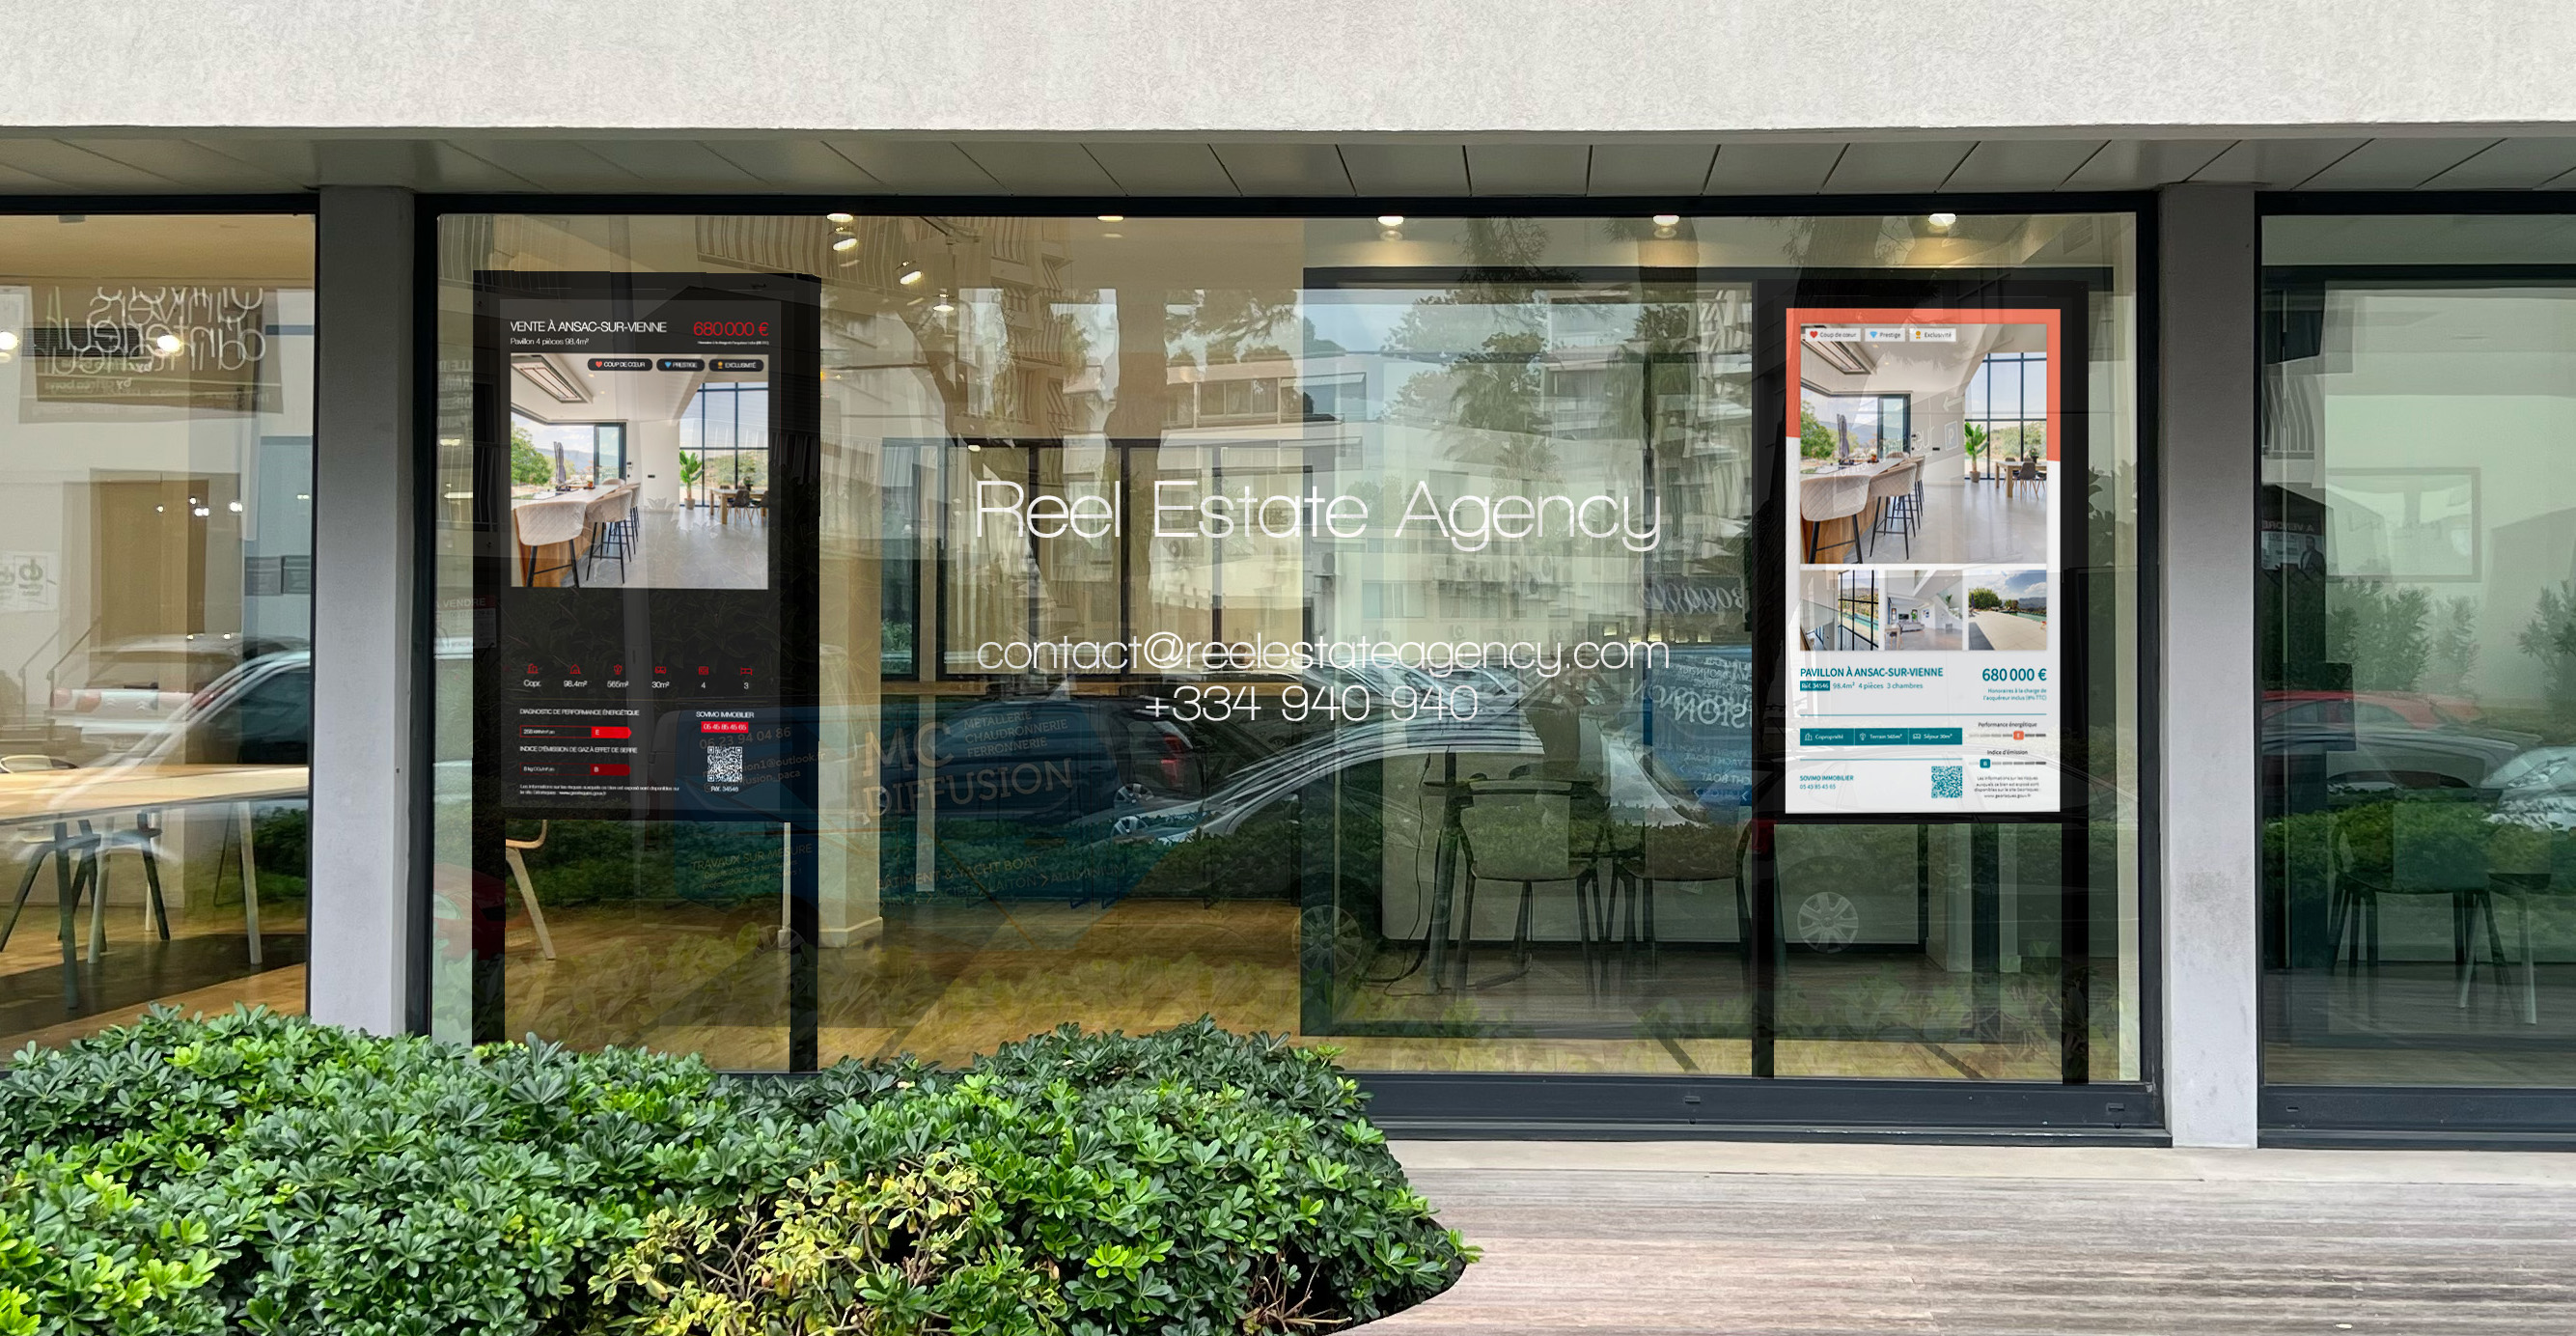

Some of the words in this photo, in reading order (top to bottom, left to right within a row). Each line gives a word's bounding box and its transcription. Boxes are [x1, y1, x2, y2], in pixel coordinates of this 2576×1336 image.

[511, 320, 545, 332] VENTE
[548, 319, 556, 332] À
[558, 321, 667, 333] ANSAC-SUR-VIENNE
[693, 321, 723, 337] 680
[725, 321, 755, 337] 000
[759, 321, 769, 337] €
[1879, 331, 1901, 340] Prestige
[977, 479, 1122, 539] Reel
[1153, 479, 1368, 539] Estate
[1395, 480, 1662, 553] Agency
[443, 598, 485, 608] VENDRE
[977, 630, 1669, 676] contact@reelestateagency.com
[1800, 667, 1844, 677] PAVILLON
[1846, 666, 1853, 677] À
[1854, 667, 1944, 677] ANSAC-SUR-VIENNE
[1982, 668, 2007, 682] 680
[2009, 668, 2035, 682] 000
[2038, 668, 2047, 682] €
[1864, 682, 1884, 691] pièces
[1144, 683, 1263, 722] +334
[1280, 683, 1371, 722] 940
[1389, 683, 1480, 722] 940
[964, 718, 1069, 744] CHAUDRONNERIE
[863, 721, 955, 778] MC
[966, 737, 1049, 759] FERRONNERIE
[862, 757, 1073, 819] DIFFUSION
[691, 853, 740, 872] TRAVAUX
[743, 850, 765, 863] SUR
[767, 843, 813, 858] MESURE
[945, 869, 954, 878] &
[957, 862, 1001, 878] YACHT
[1004, 855, 1039, 871] BOAT
